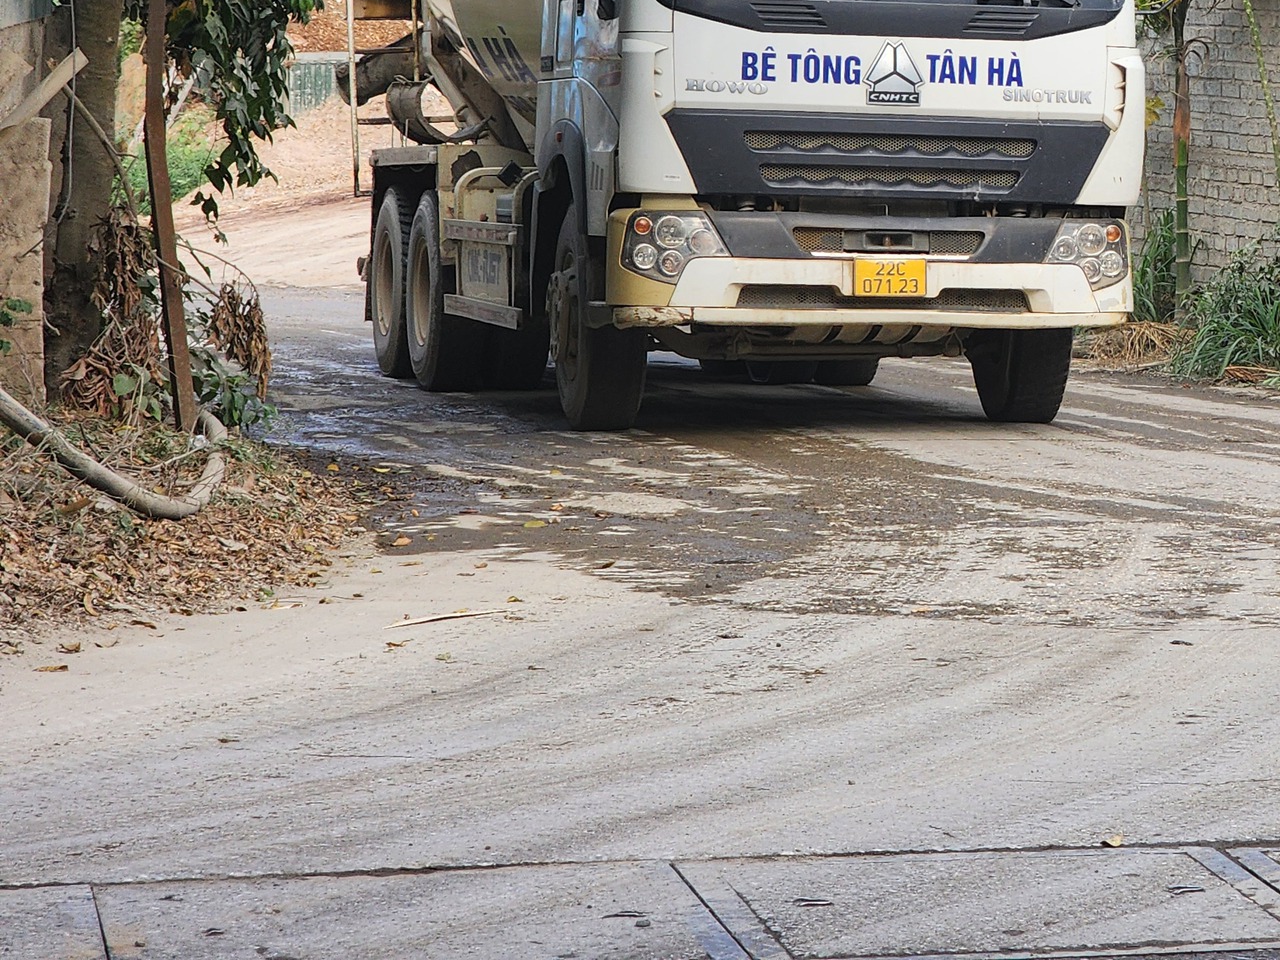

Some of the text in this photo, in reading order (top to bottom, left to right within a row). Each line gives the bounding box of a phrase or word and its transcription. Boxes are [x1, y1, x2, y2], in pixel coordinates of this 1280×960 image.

[741, 46, 1023, 88] BÊ TÔNG TÂN HÀ
[685, 79, 769, 95] HOWO
[870, 93, 918, 102] CNHTC
[1003, 89, 1092, 105] SINOTRUK
[876, 261, 906, 276] 22C
[863, 278, 918, 294] 071.23
